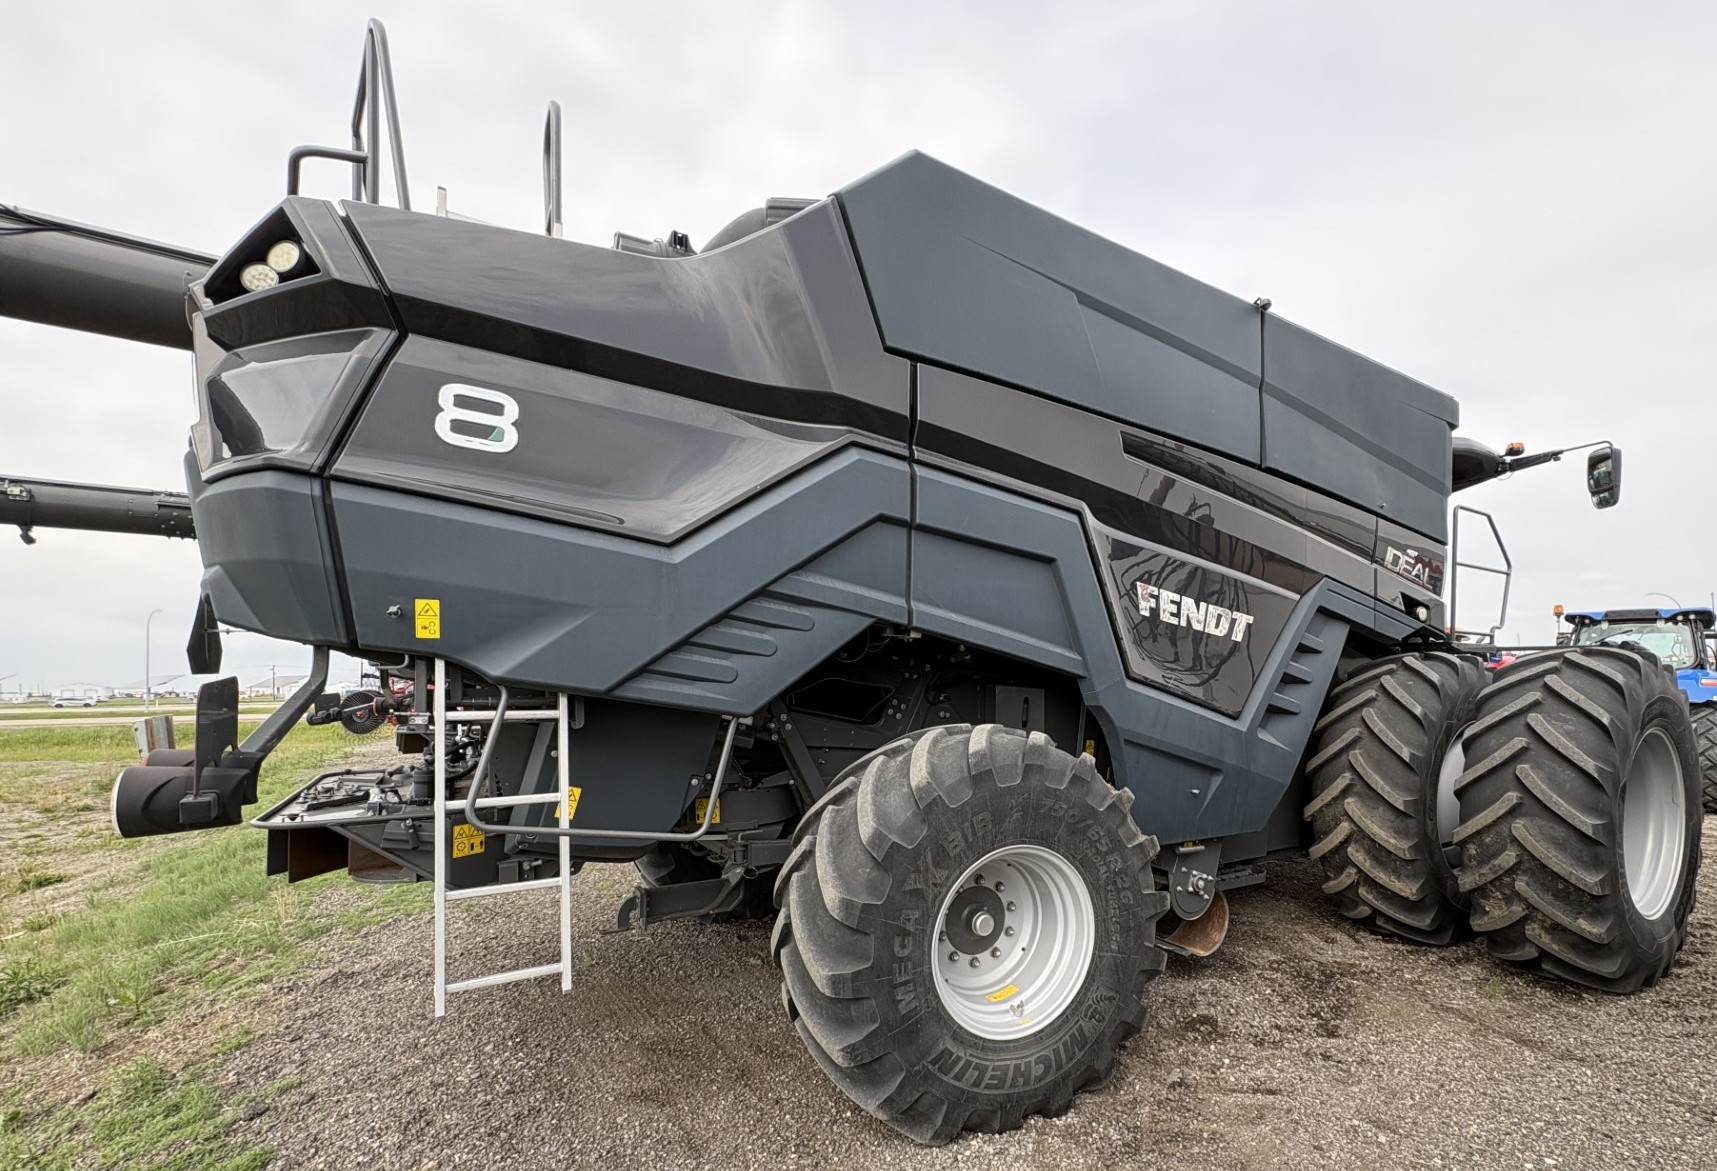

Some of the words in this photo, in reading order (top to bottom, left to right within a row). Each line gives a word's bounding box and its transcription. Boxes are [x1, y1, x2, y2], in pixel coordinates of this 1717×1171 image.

[434, 383, 520, 453] 8
[1384, 546, 1433, 589] IDEAL
[1136, 581, 1254, 642] FENDT
[928, 1022, 1090, 1091] MICHELIN
